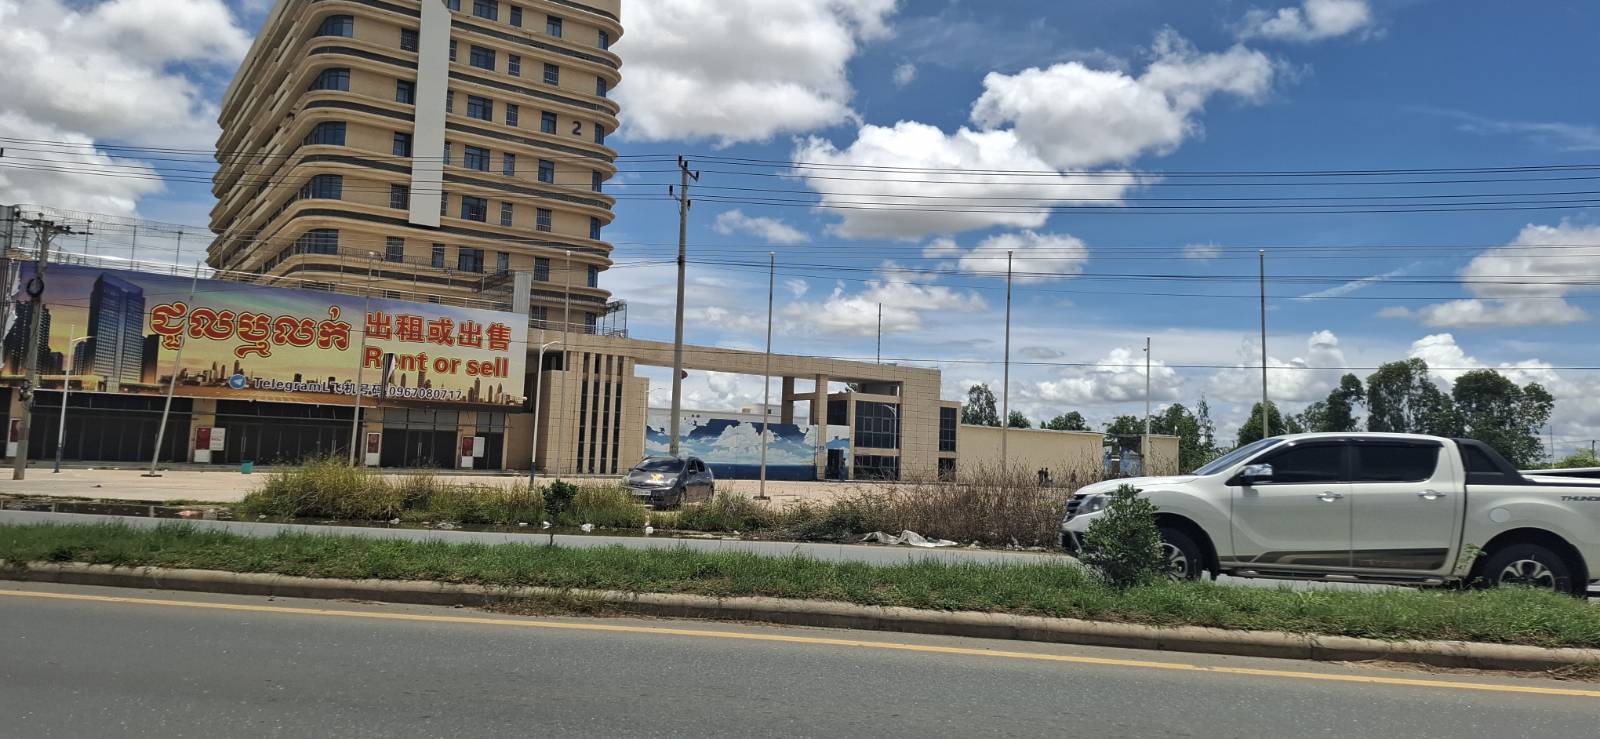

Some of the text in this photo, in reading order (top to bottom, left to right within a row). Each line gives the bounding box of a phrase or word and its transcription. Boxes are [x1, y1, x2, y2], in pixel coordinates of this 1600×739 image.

[572, 120, 582, 136] 2
[365, 311, 512, 353] 出租或出售
[363, 345, 510, 378] Rnt or sell
[389, 386, 463, 400] 0967080717
